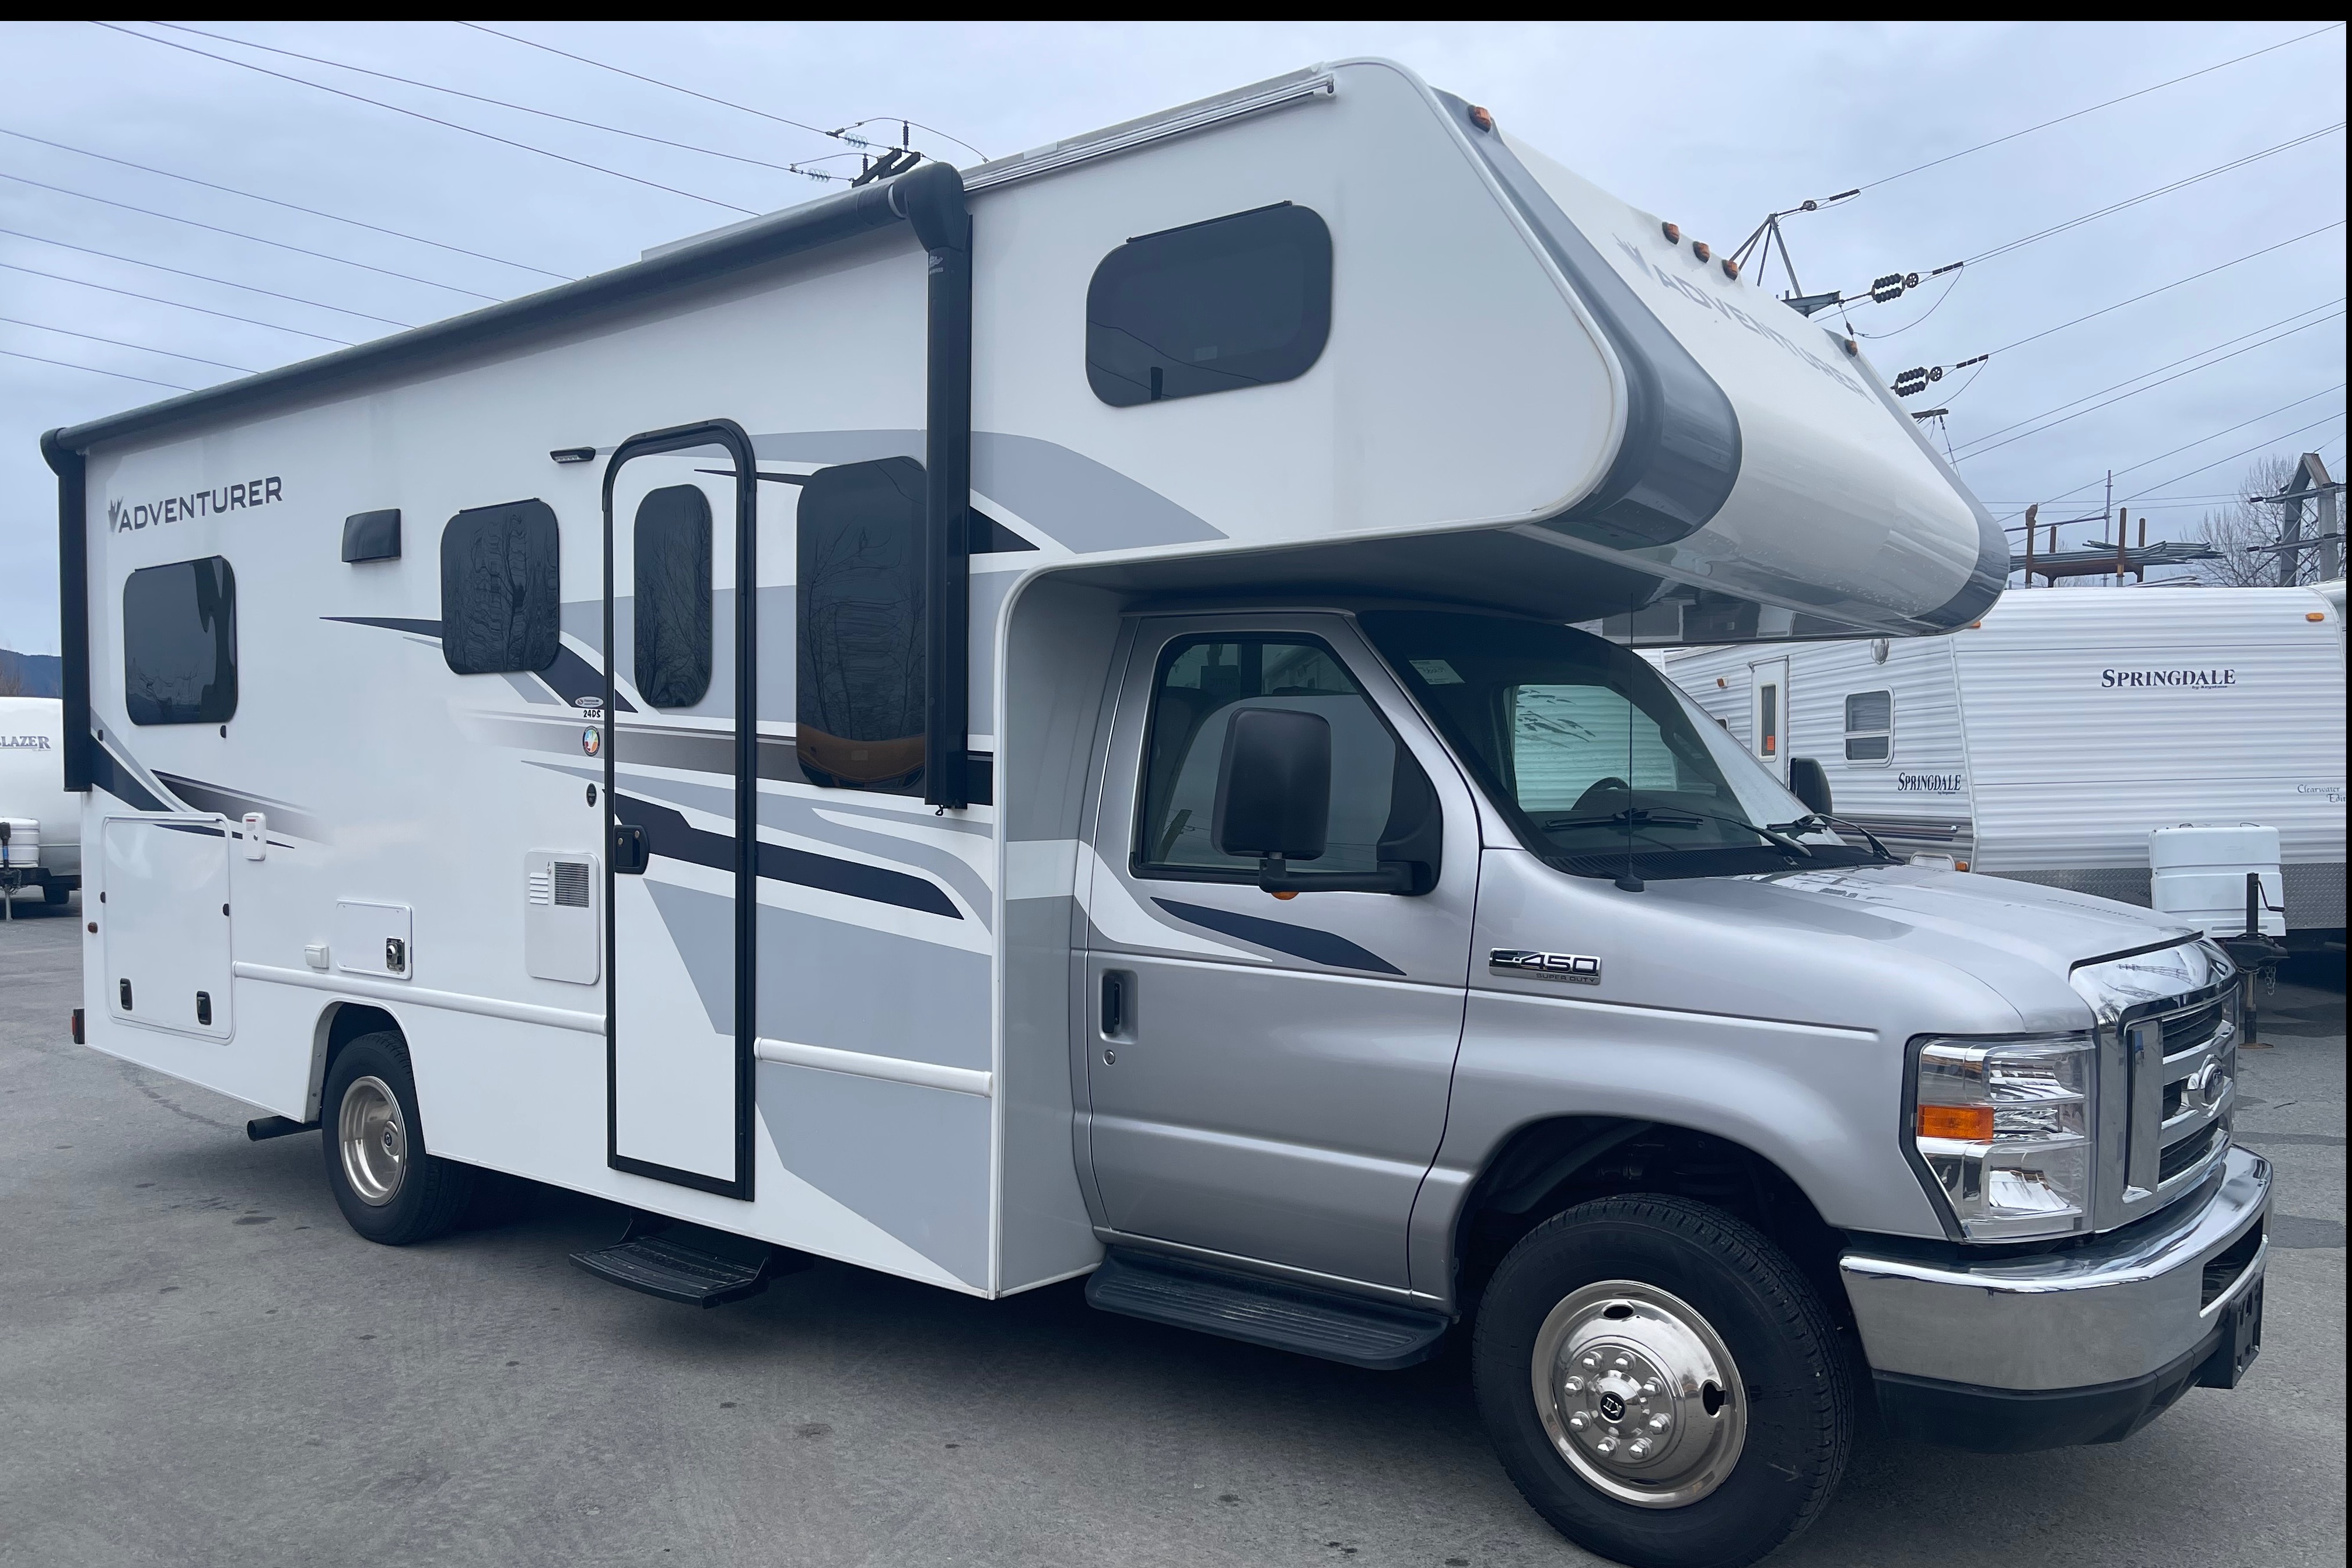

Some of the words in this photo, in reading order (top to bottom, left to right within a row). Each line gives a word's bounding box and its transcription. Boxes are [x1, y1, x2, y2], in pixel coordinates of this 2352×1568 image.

[1652, 264, 1876, 405] ADVENTURER
[118, 476, 283, 533] ADVENTURER
[583, 709, 601, 718] 24DS
[0, 736, 51, 749] LAZER
[2297, 784, 2340, 793] Clearwater
